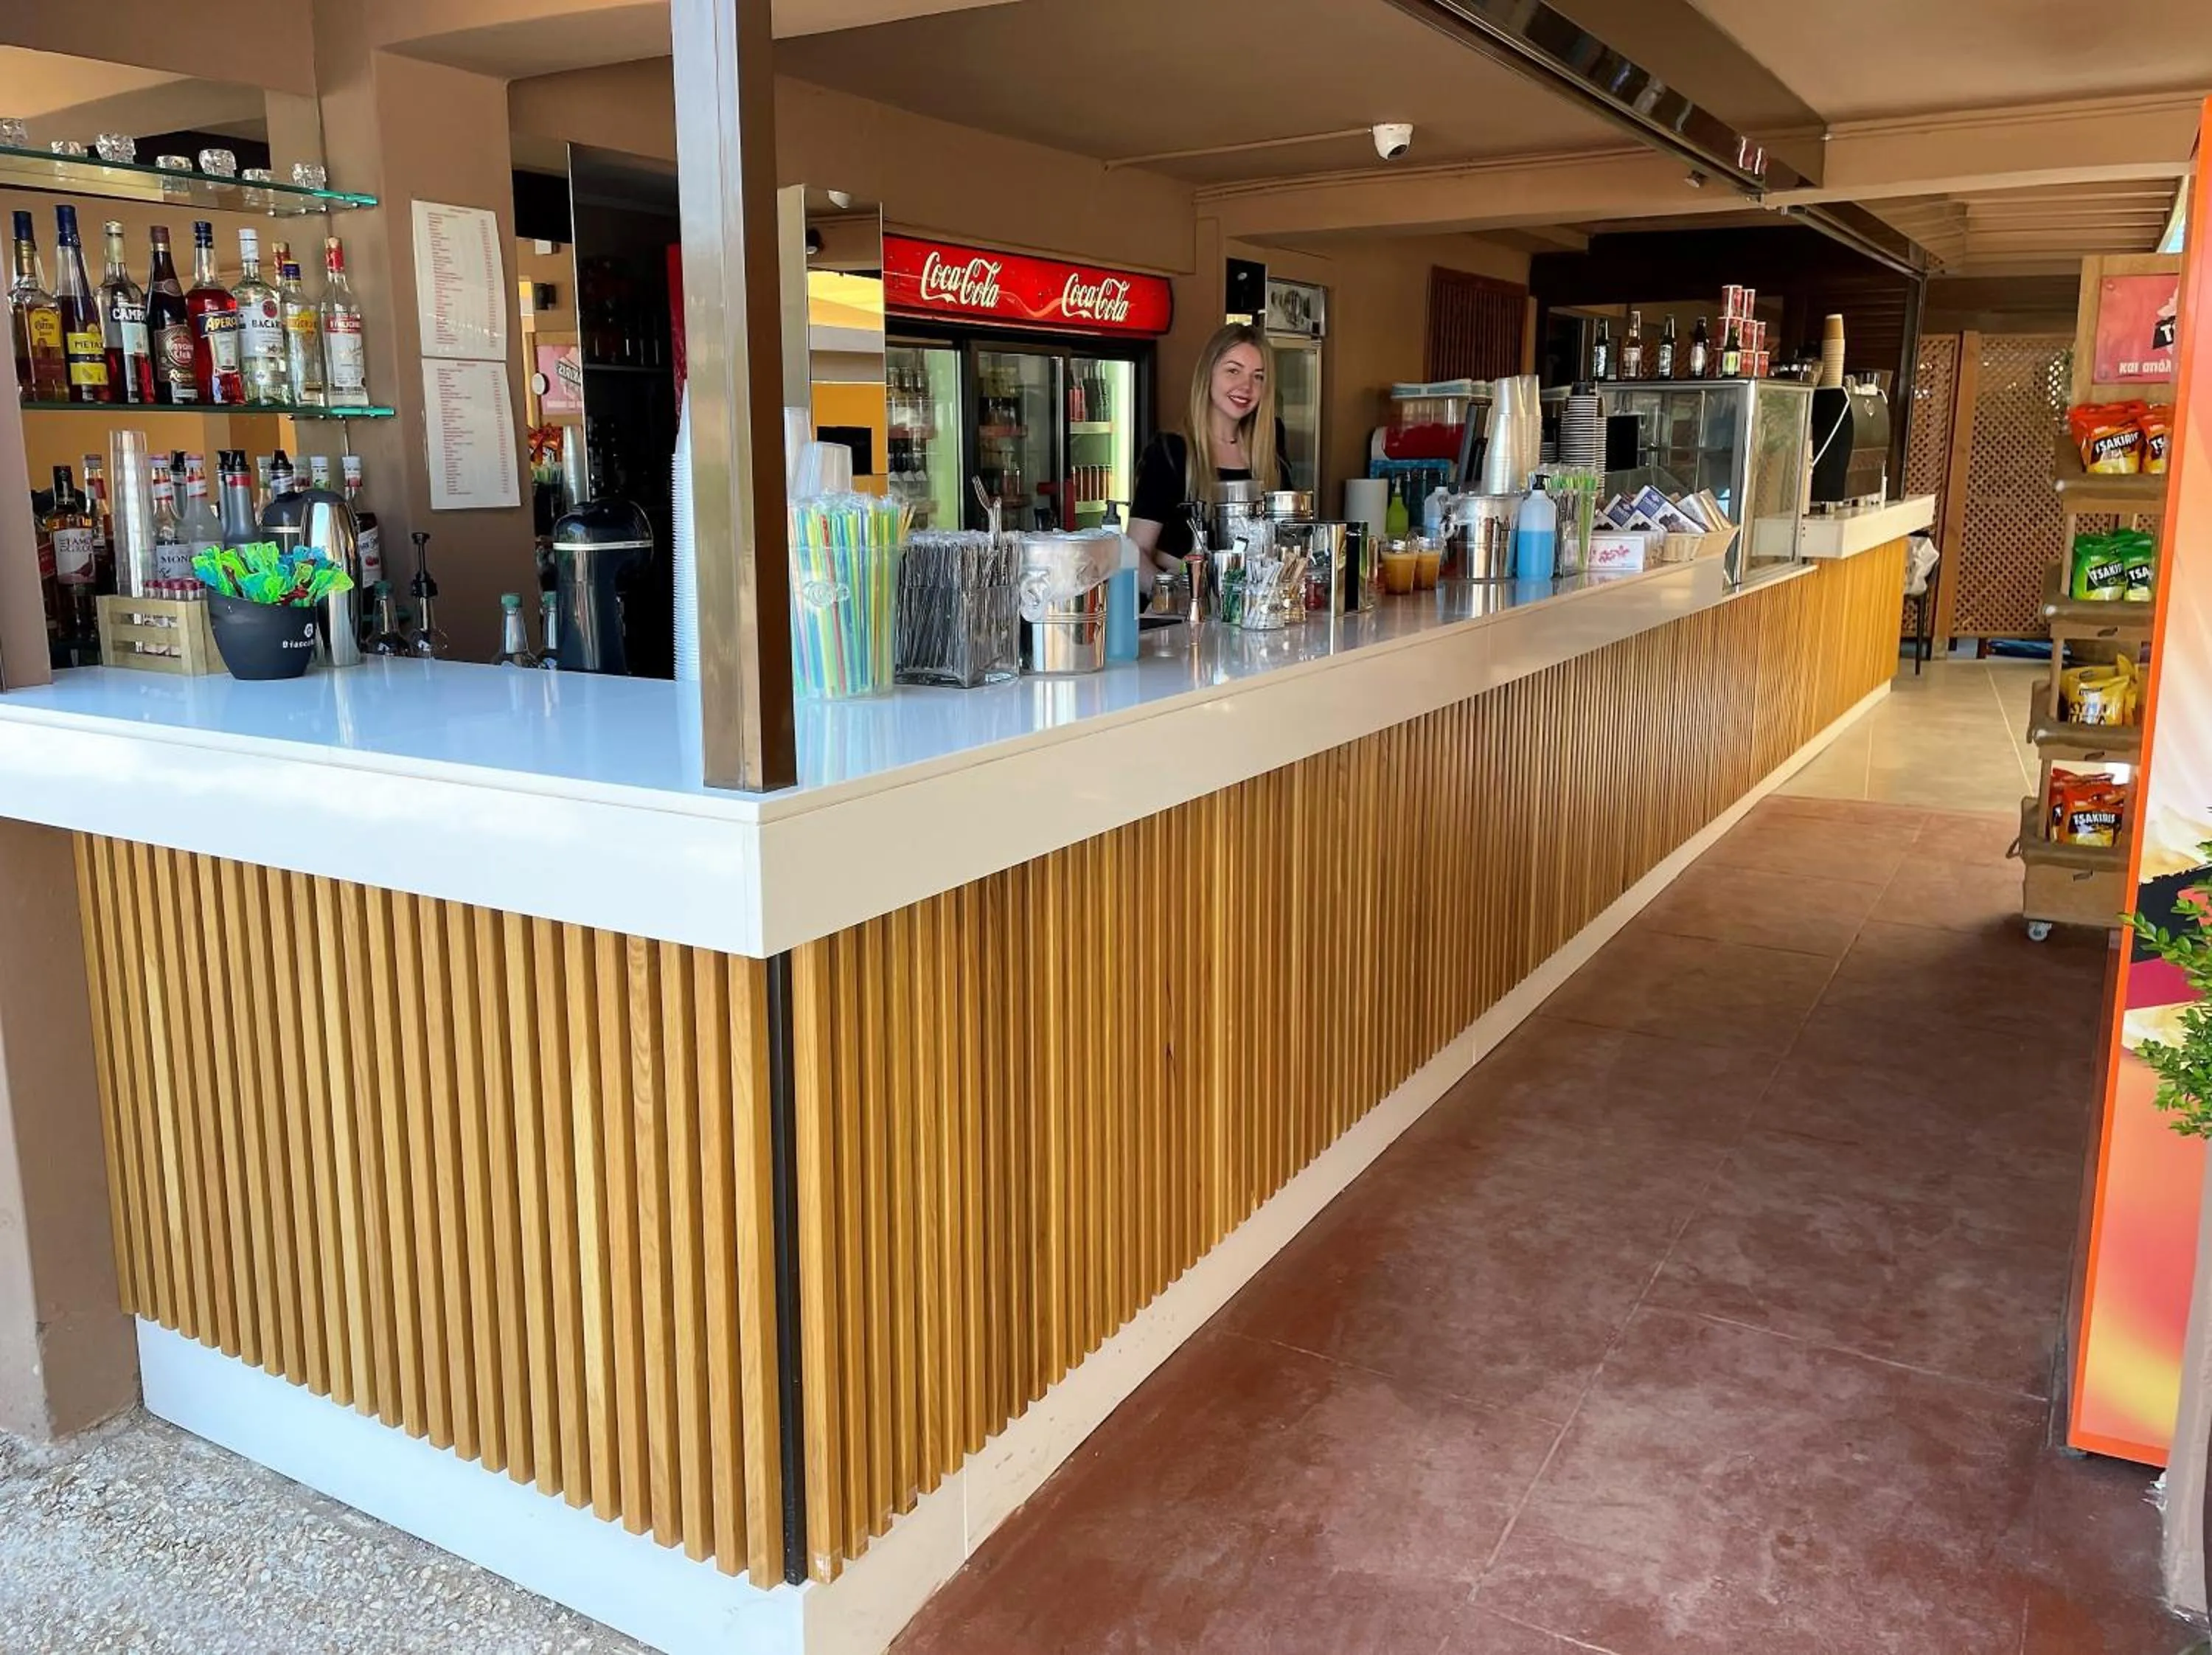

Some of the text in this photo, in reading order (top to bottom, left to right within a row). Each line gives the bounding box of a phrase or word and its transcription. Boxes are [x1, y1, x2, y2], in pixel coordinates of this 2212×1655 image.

[921, 251, 1002, 308] Coca-Cola
[1061, 273, 1130, 322] Coca-Cola
[205, 316, 237, 331] APERO
[2142, 359, 2171, 373] απόλ
